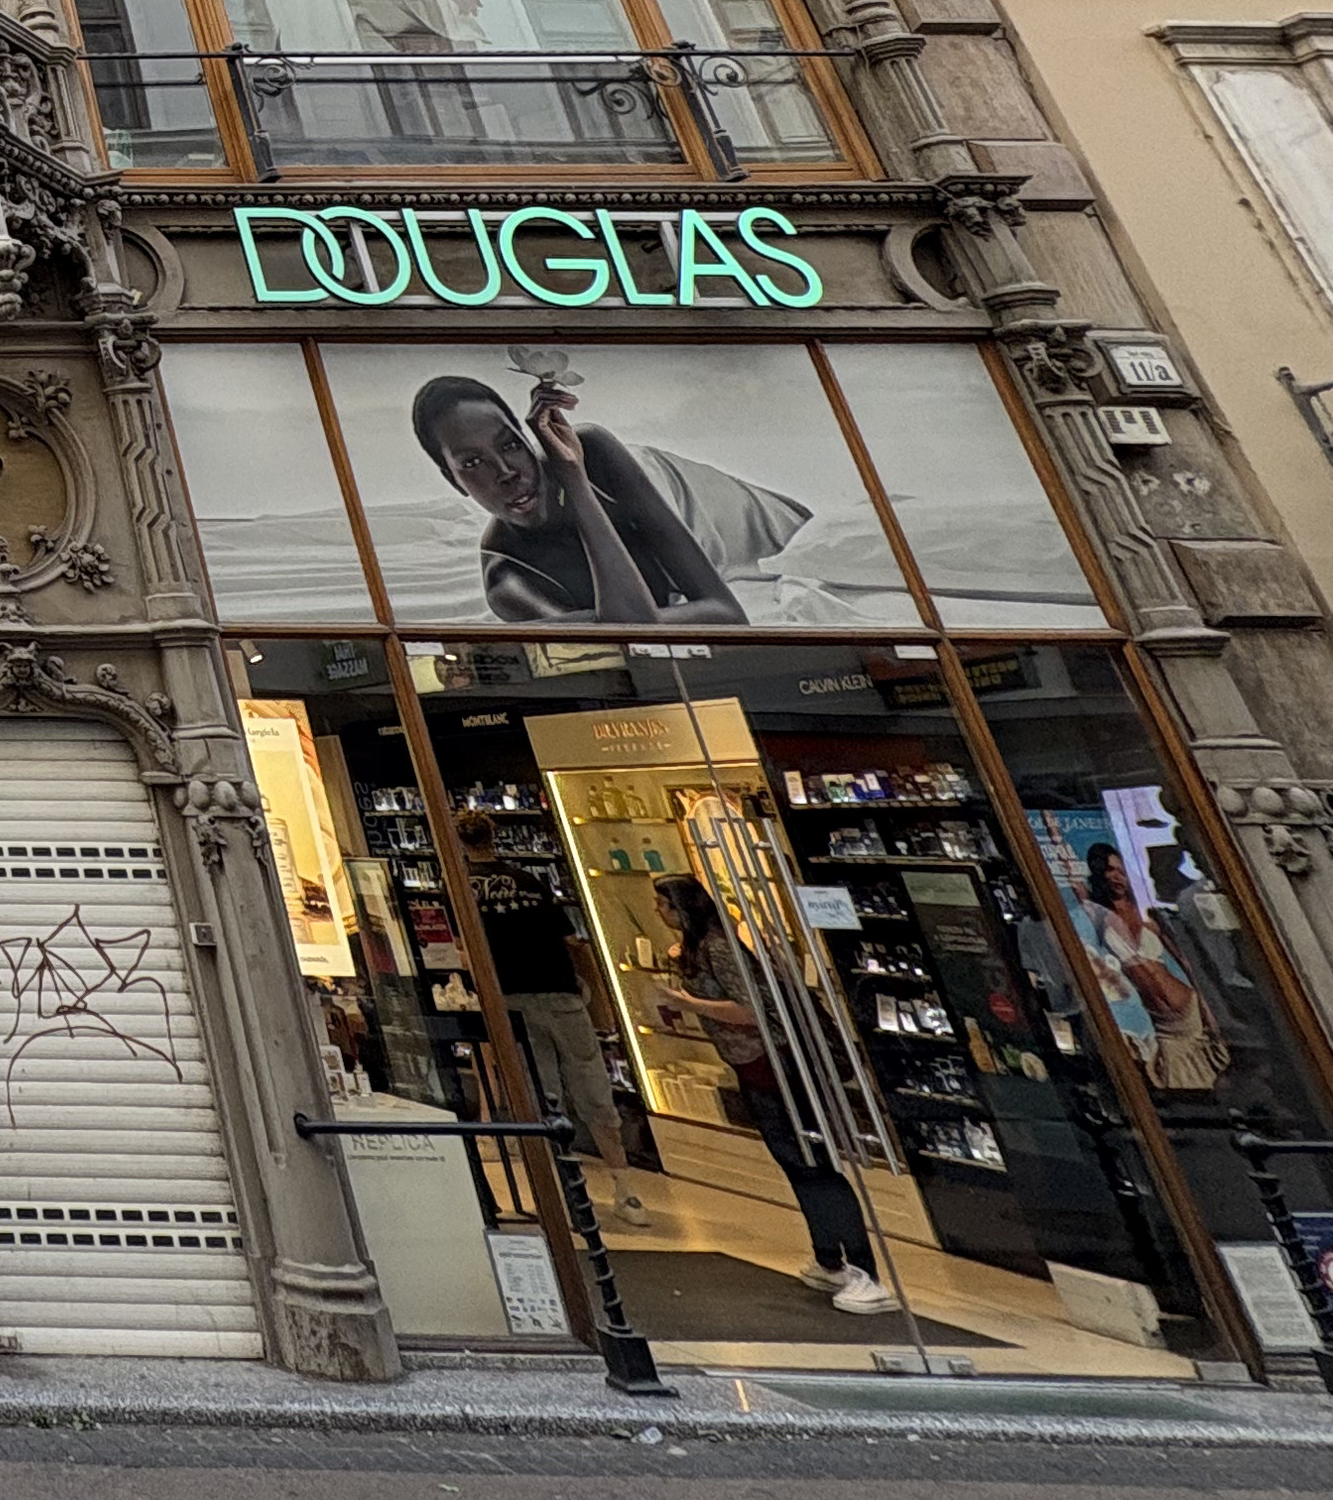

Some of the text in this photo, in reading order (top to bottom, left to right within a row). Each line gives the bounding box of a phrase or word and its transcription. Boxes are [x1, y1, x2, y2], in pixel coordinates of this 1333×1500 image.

[234, 206, 823, 308] DOUGLAS
[1129, 361, 1174, 382] 11/a
[799, 674, 874, 695] CALVIN KLEIN
